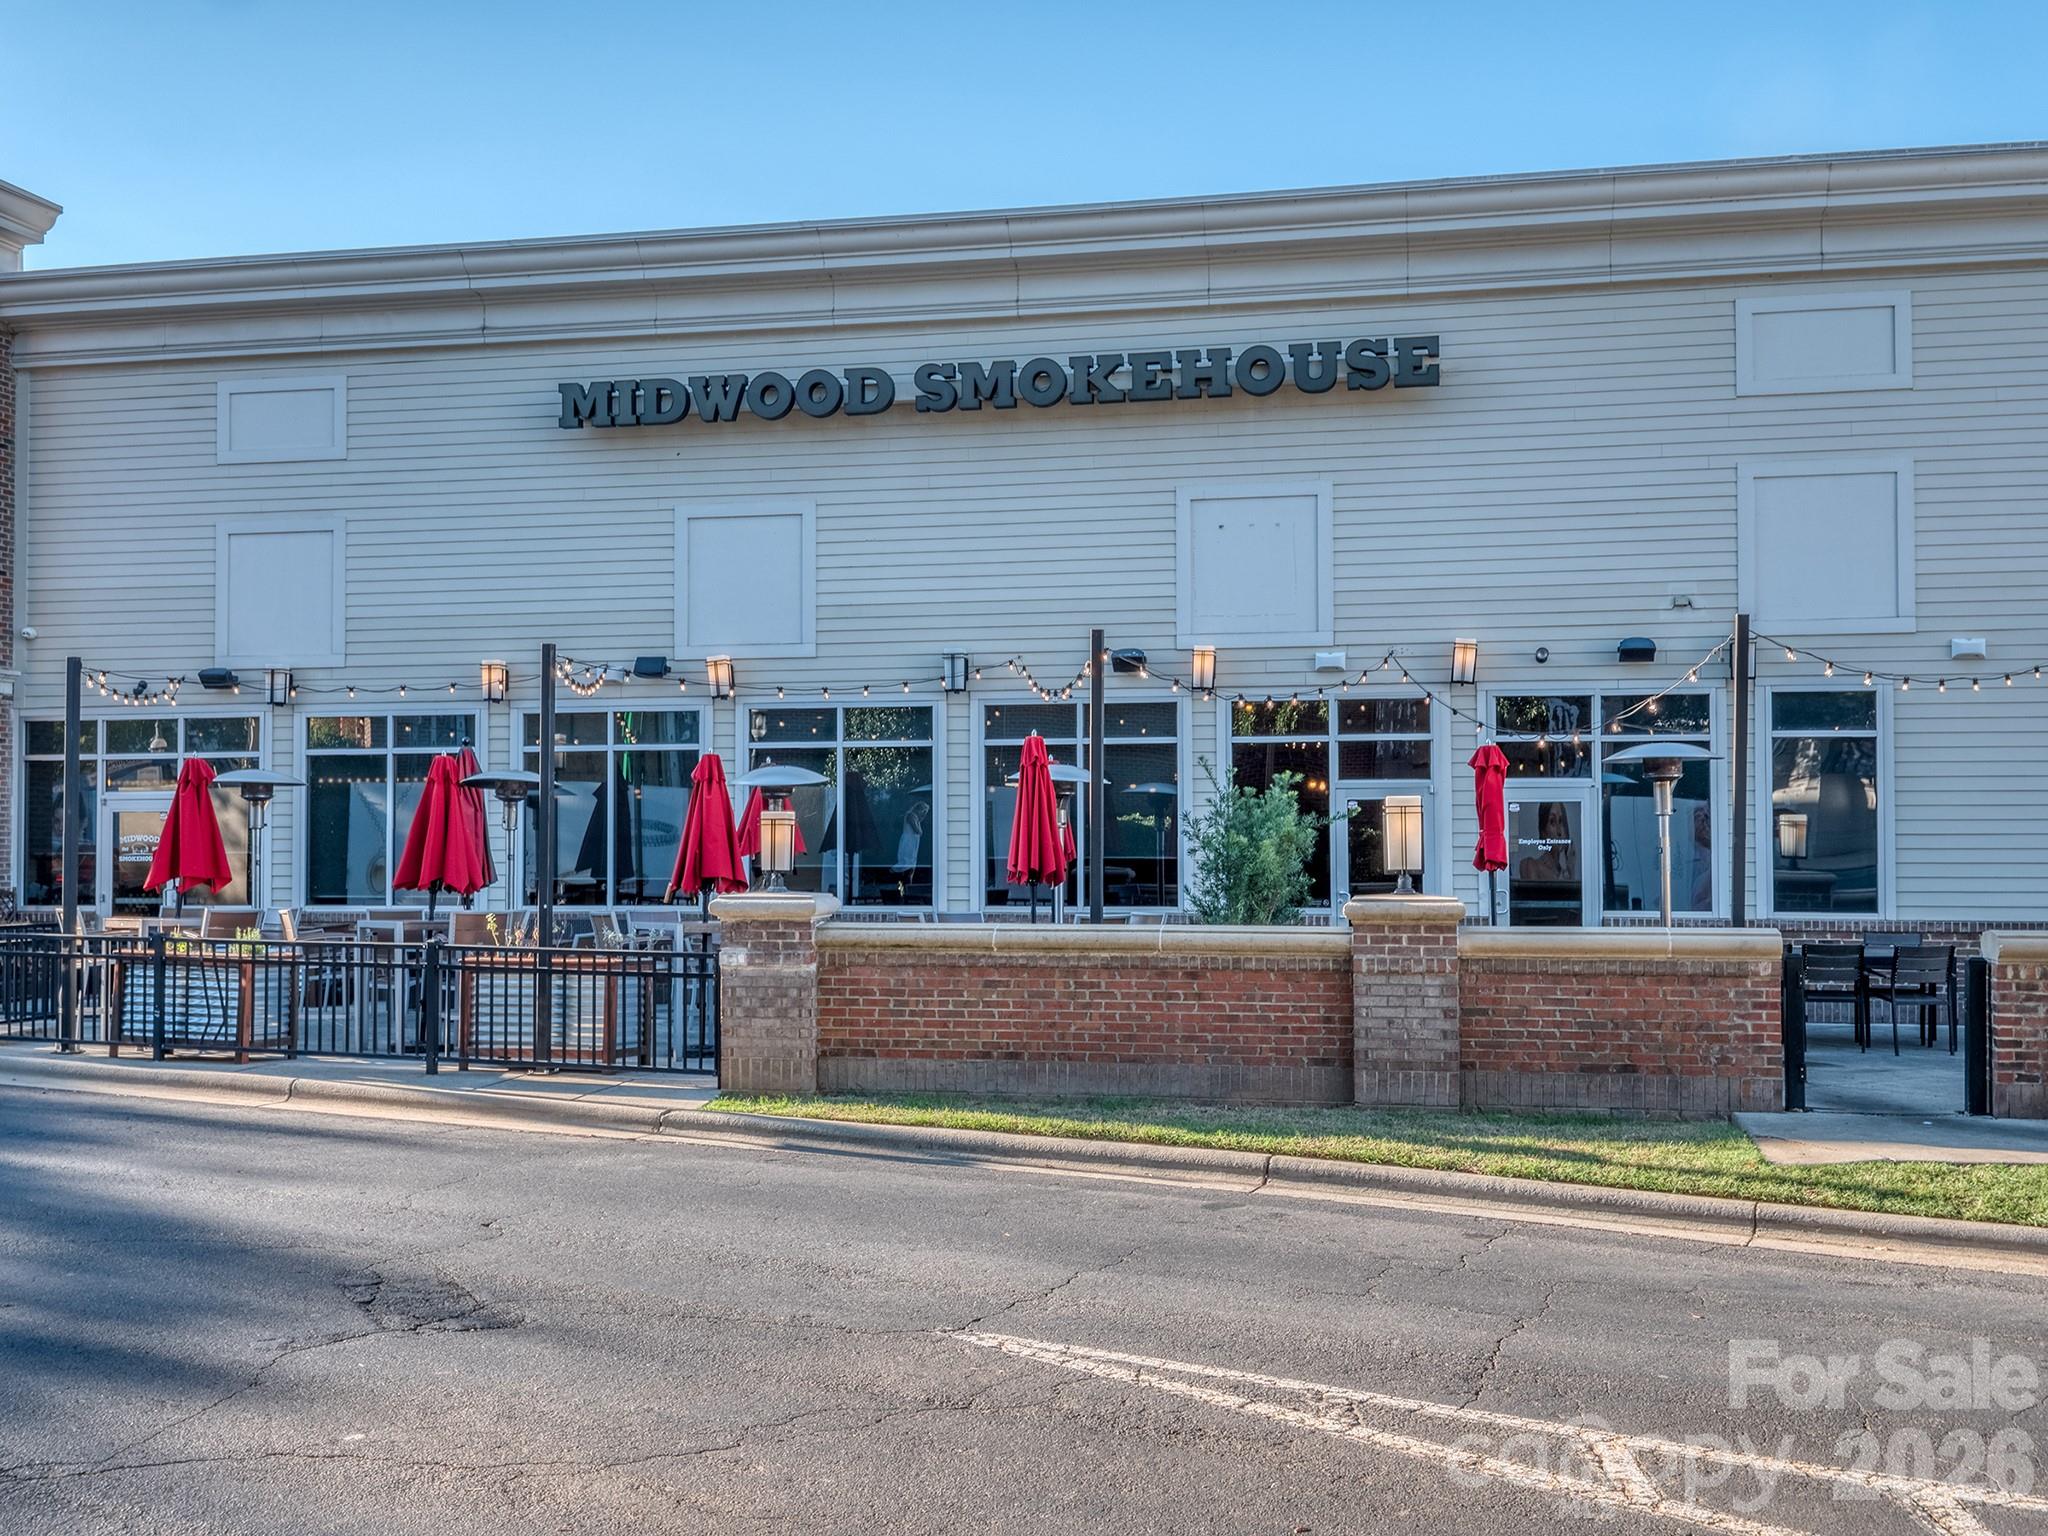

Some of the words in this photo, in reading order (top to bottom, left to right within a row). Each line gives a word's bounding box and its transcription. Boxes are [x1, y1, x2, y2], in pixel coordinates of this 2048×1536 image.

[558, 367, 896, 429] MIDWOOD
[914, 335, 1440, 412] SMOKEHOUSE
[120, 835, 160, 844] MIDWOOD
